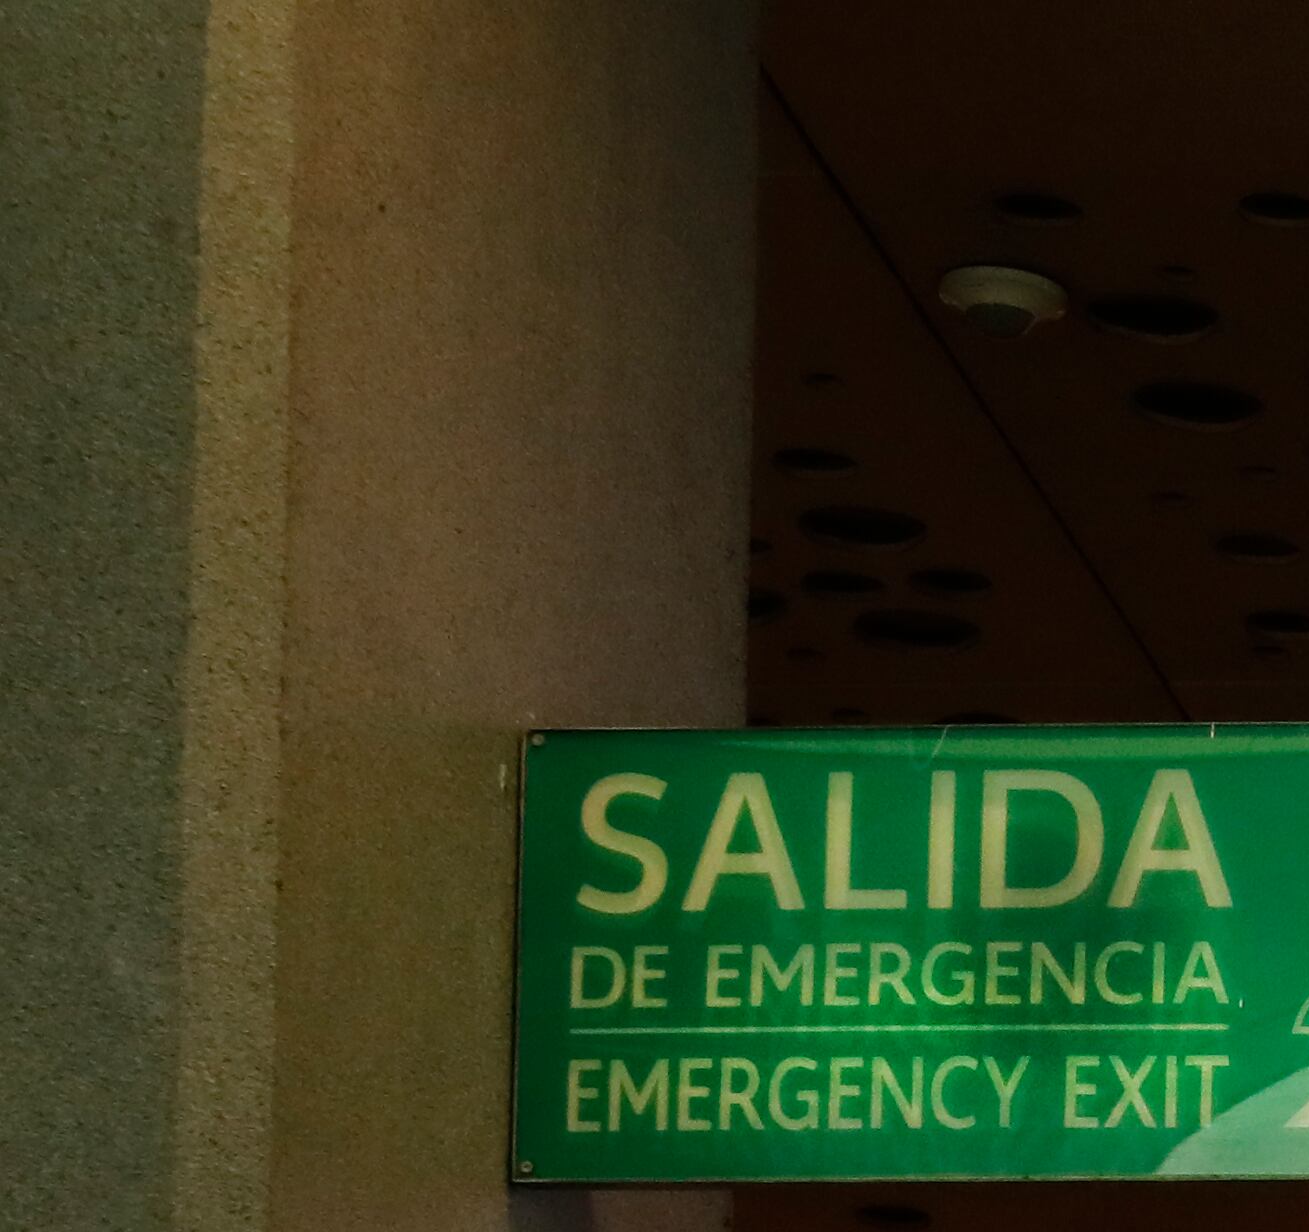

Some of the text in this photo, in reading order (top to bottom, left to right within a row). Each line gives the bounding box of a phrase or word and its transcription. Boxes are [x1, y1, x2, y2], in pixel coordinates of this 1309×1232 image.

[576, 768, 1233, 914] SALIDA
[569, 940, 1230, 1010] DE EMERGENCIA
[566, 1055, 1230, 1132] EMERGENCY EXIT
